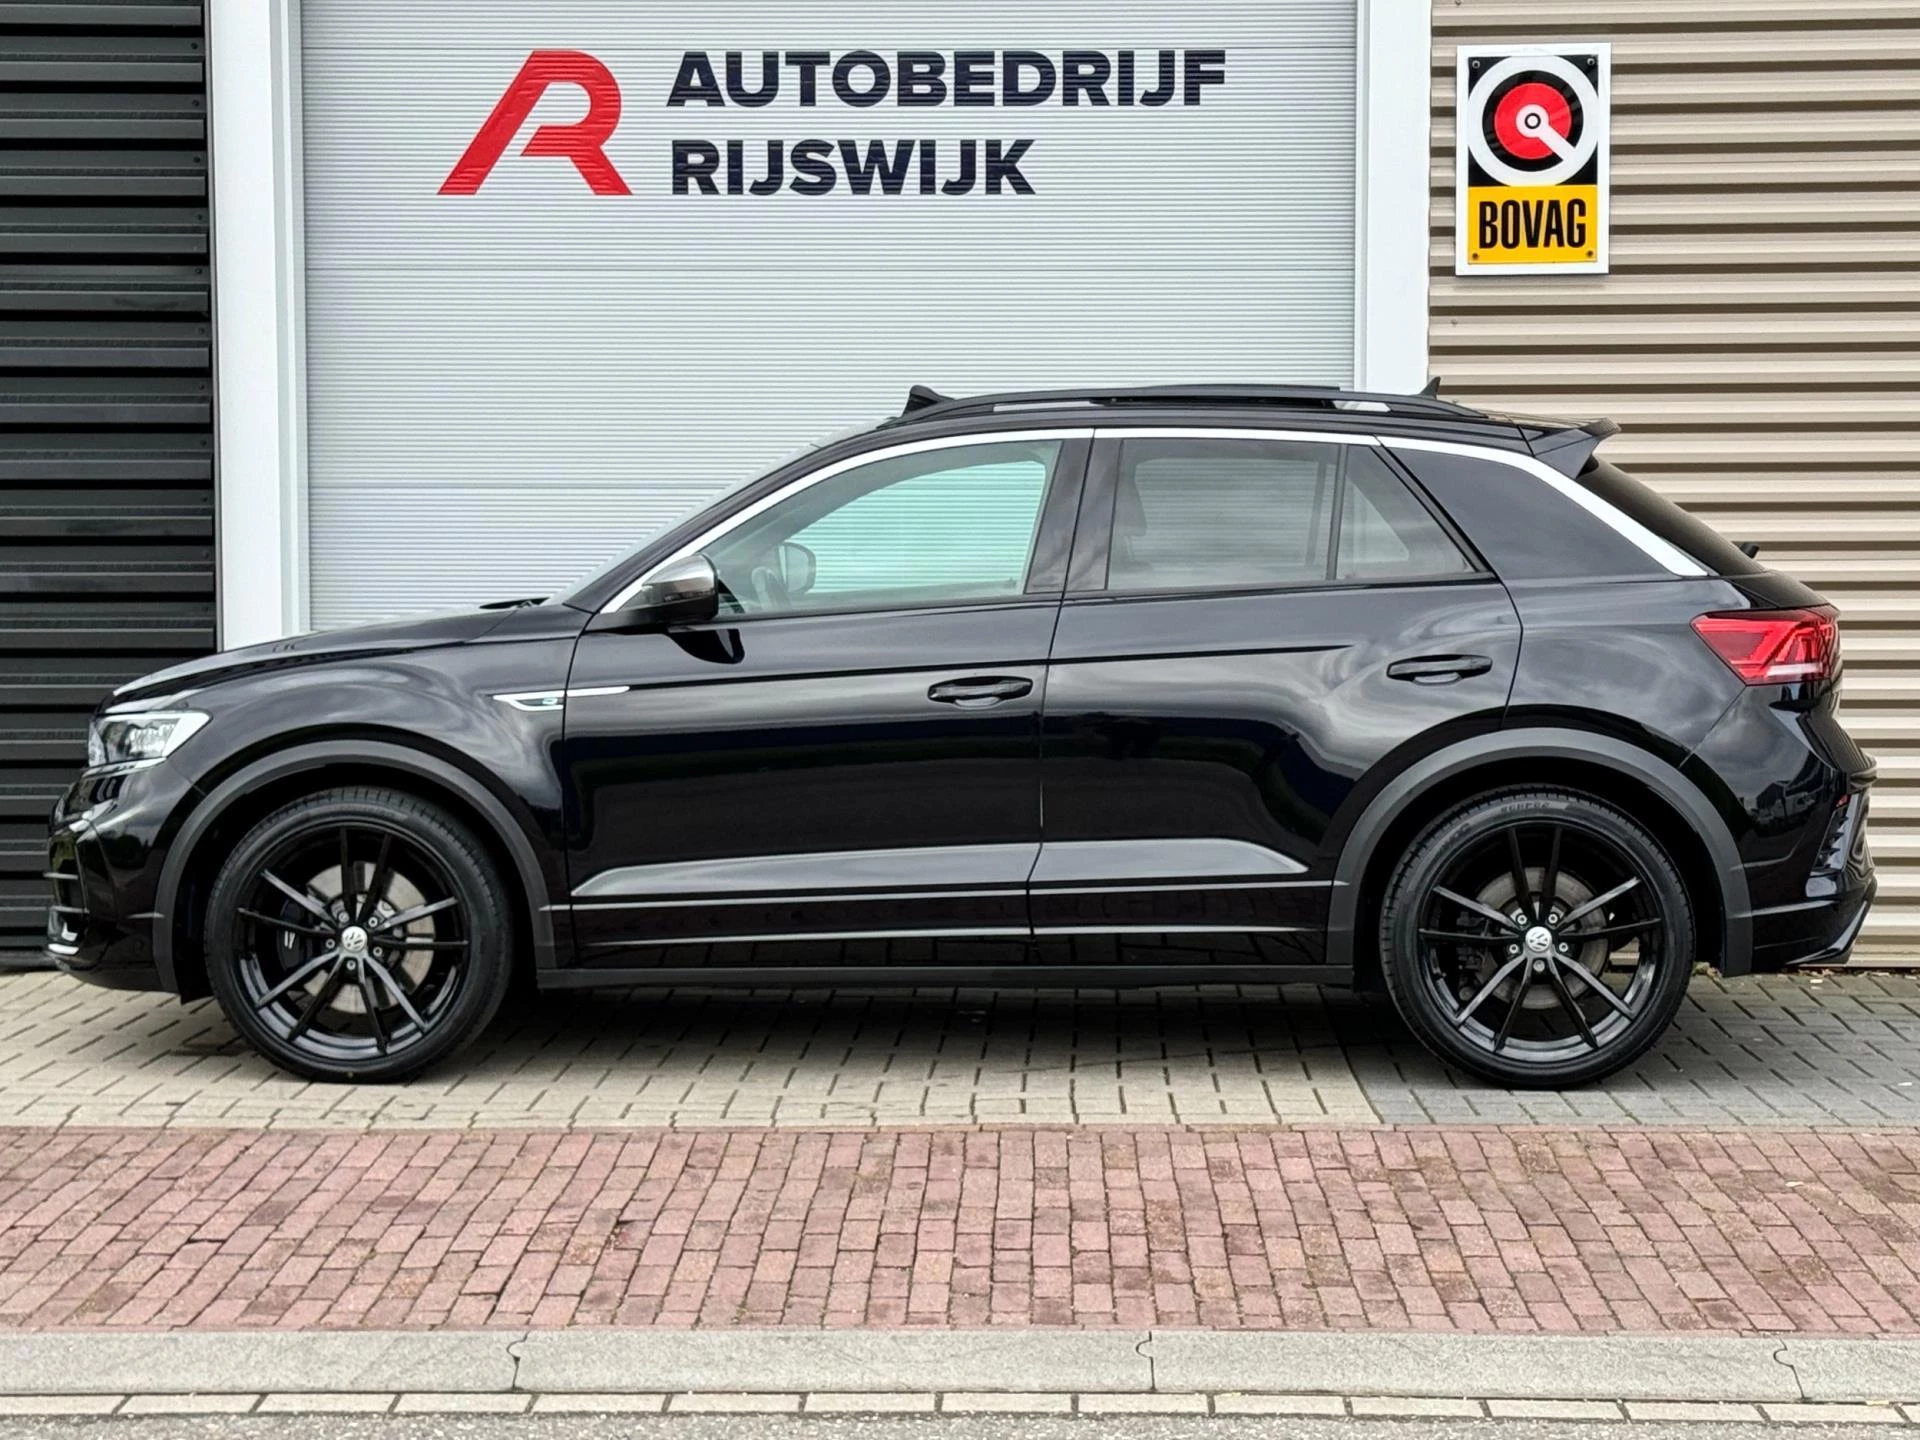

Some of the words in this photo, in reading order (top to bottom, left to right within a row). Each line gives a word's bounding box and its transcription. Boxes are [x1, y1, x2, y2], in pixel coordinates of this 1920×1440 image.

[667, 49, 1226, 107] AUTOBEDRIJF
[673, 139, 1036, 195] RIJSWIJK
[1479, 198, 1586, 249] BOVAG
